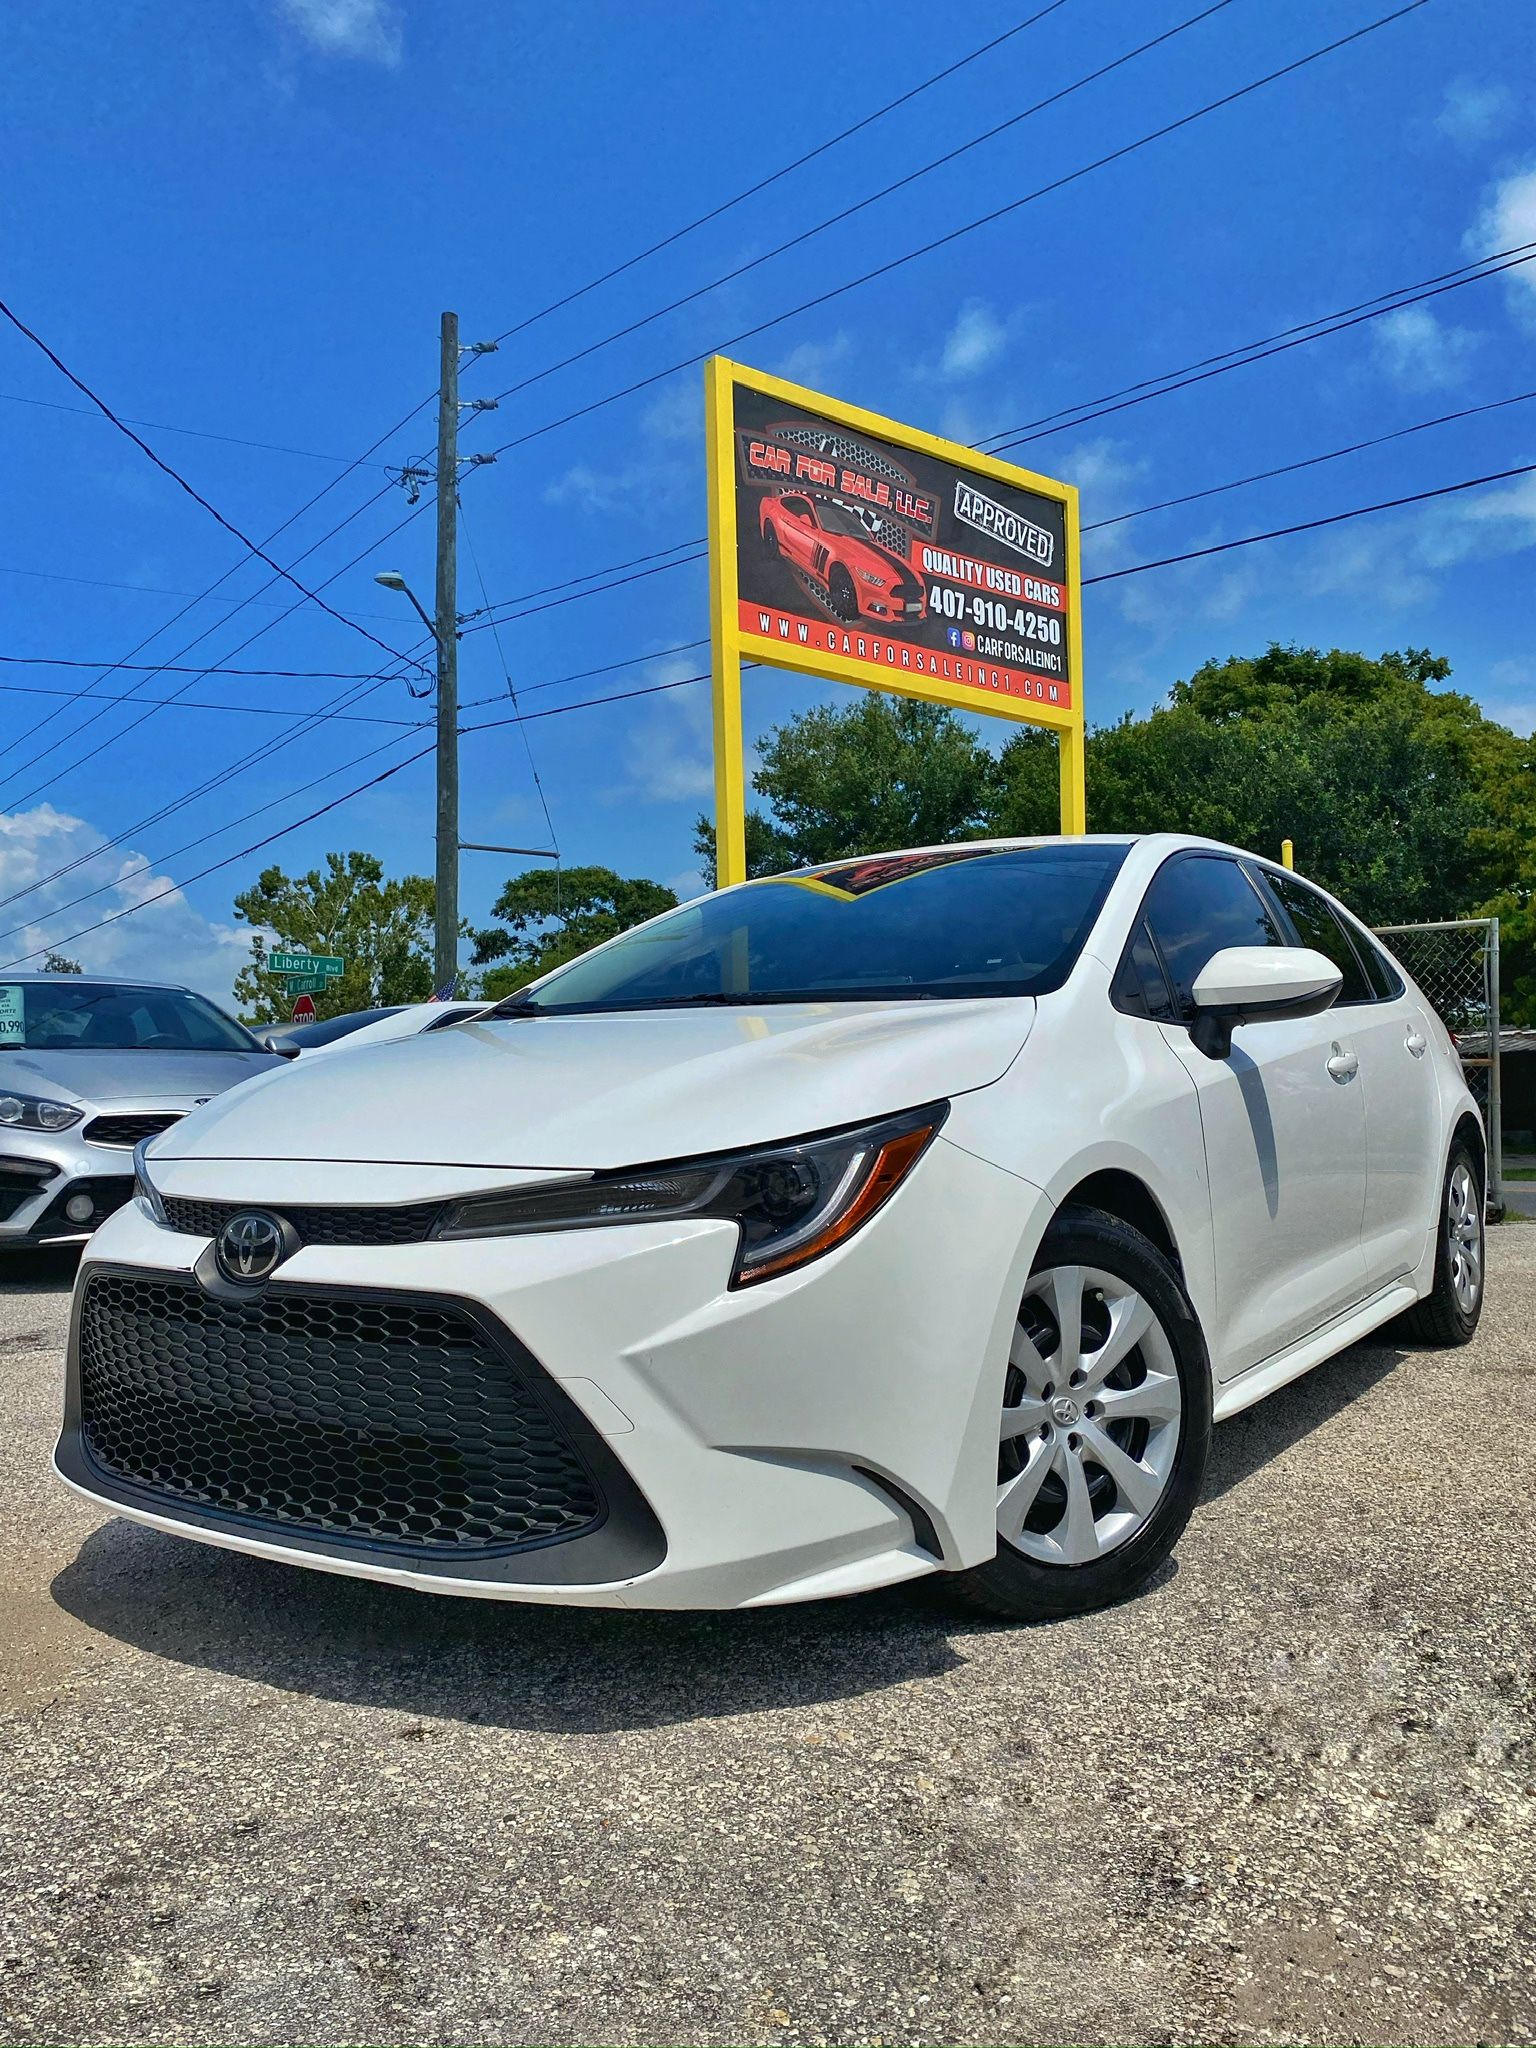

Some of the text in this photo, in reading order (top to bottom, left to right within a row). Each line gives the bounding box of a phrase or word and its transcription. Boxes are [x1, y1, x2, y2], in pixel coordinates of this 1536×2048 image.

[749, 441, 791, 475] CAR
[796, 454, 836, 488] FOR
[840, 469, 893, 511] SALE,
[959, 491, 1049, 559] APPROVED
[922, 547, 1060, 607] QUALITY USED CARS
[929, 585, 1061, 646] 407-910-4250
[757, 612, 1060, 702] WWW.CARFORSALEINC1.COM
[976, 634, 1062, 673] CARFORSALEINC1
[274, 955, 339, 974] Liberty Blvd
[297, 977, 317, 991] Carroll
